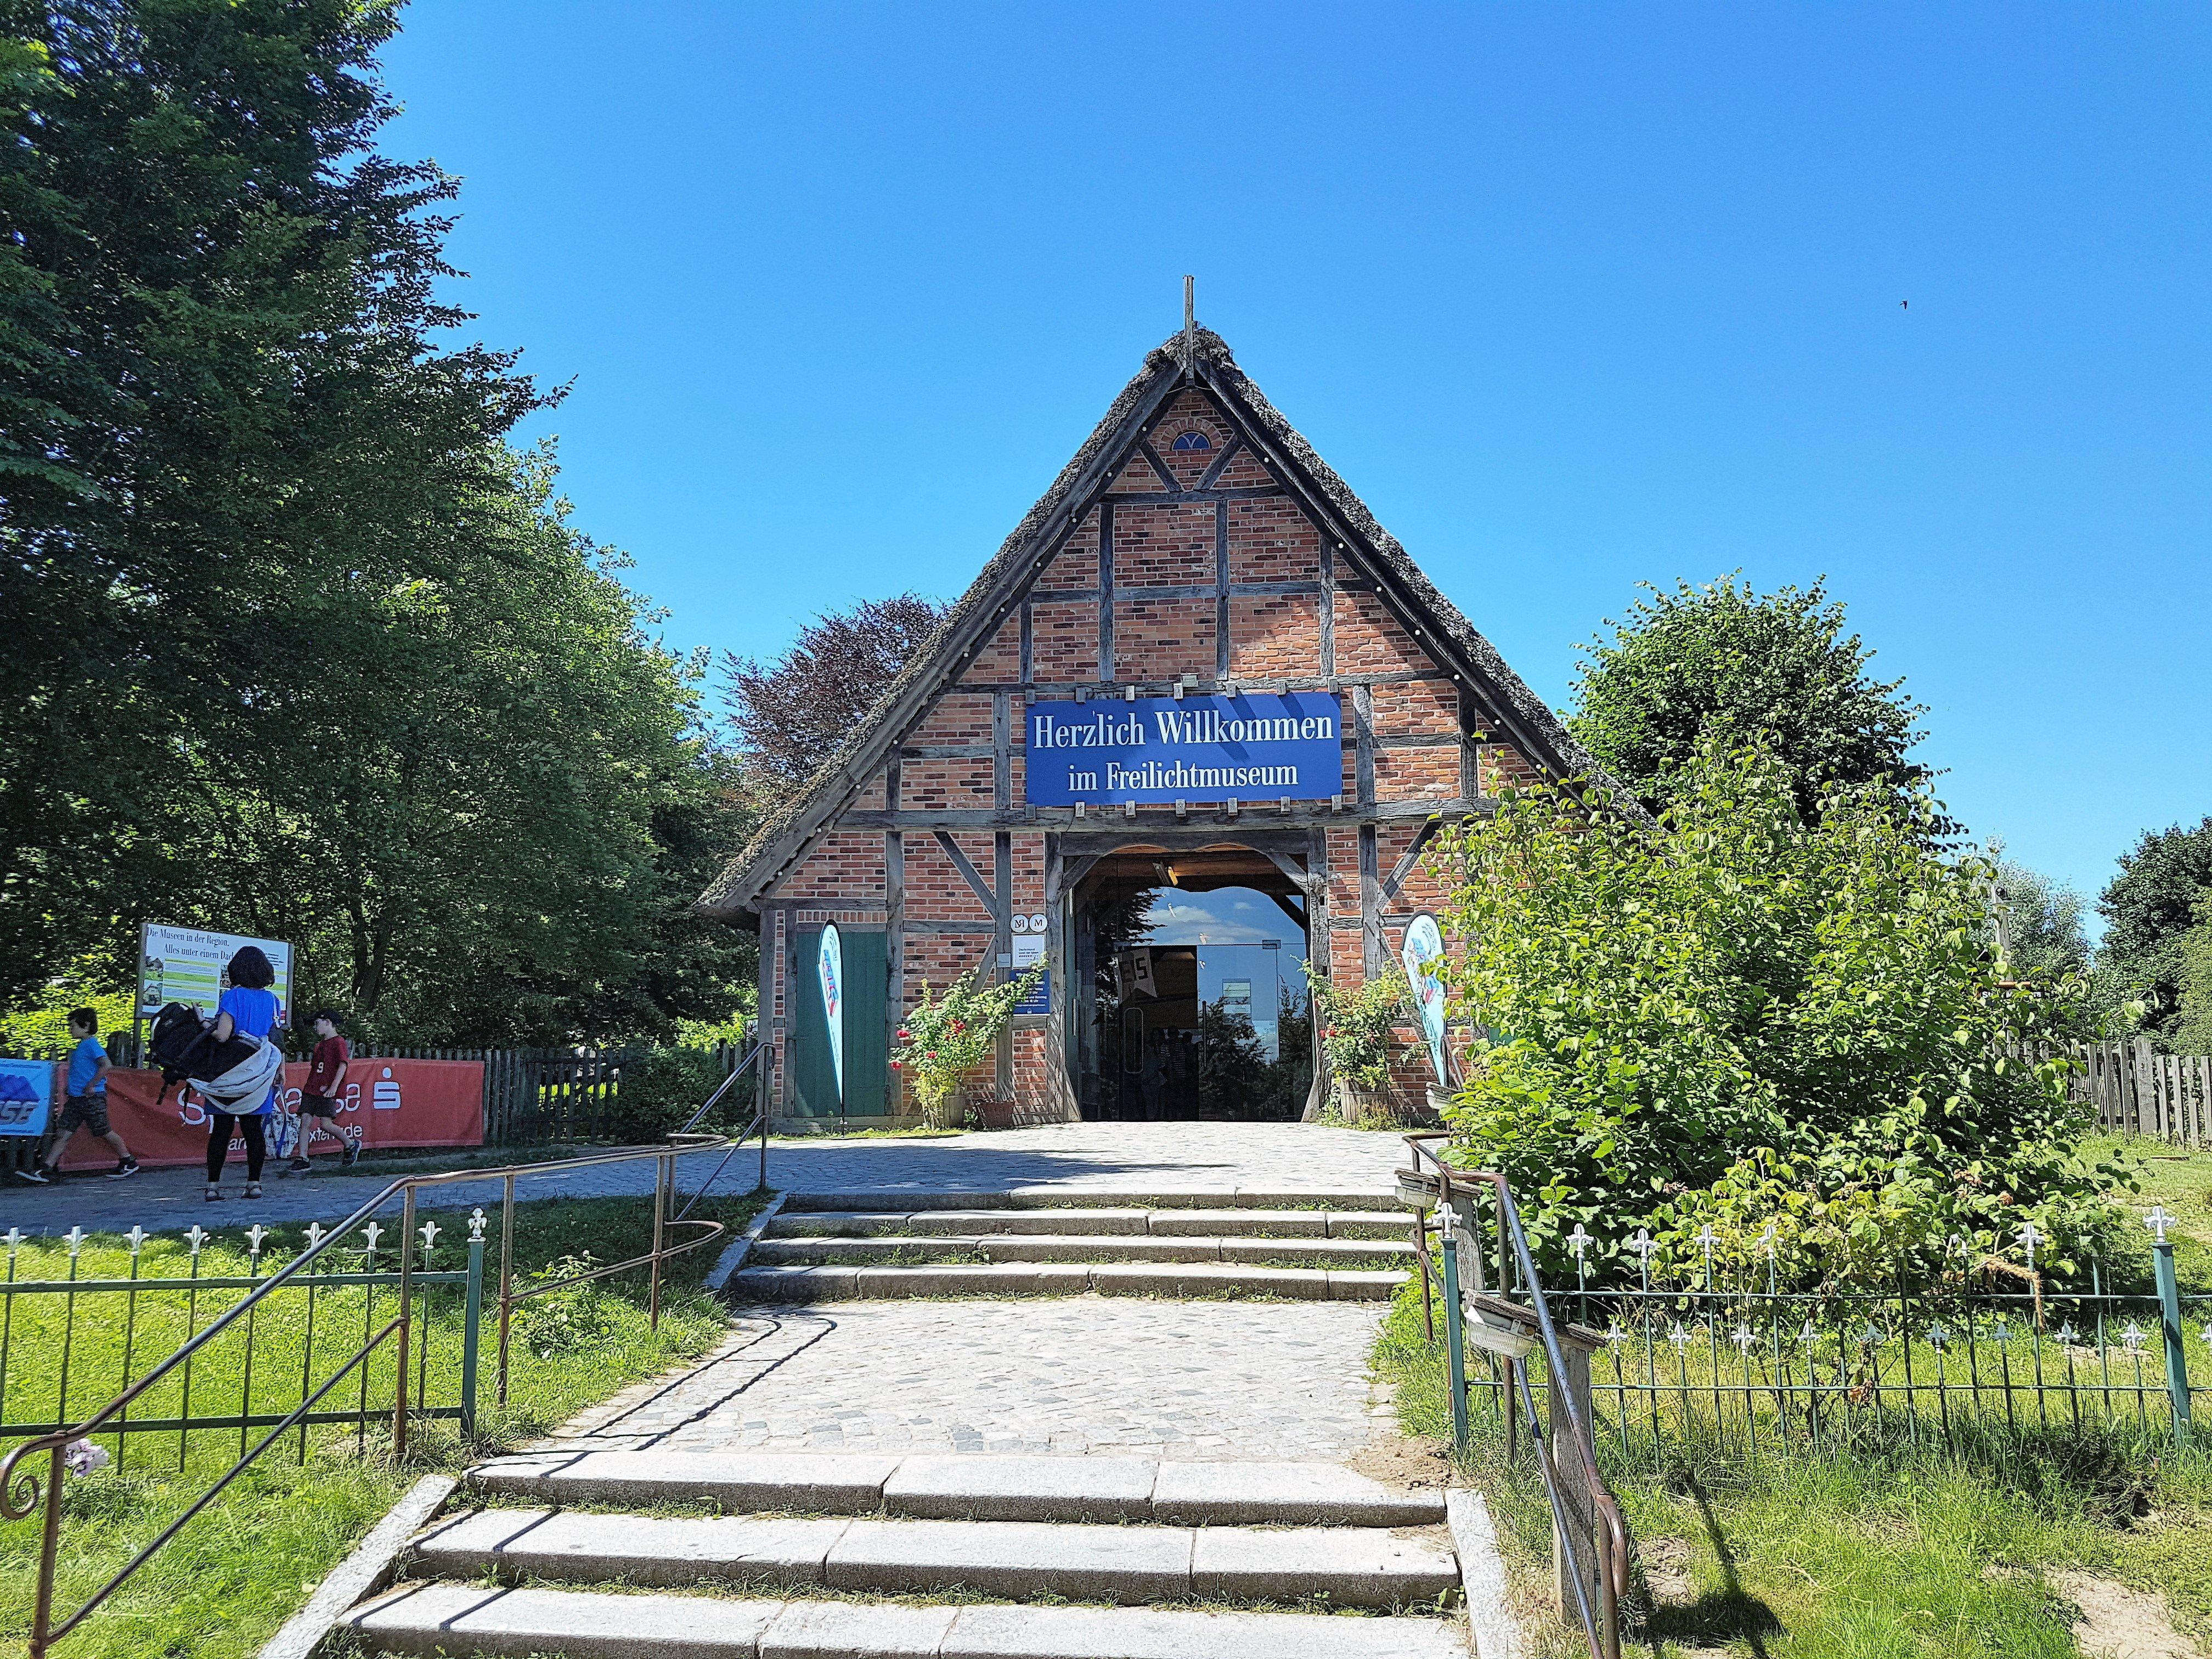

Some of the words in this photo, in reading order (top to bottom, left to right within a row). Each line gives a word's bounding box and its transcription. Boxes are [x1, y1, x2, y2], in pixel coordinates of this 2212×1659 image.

[1034, 713, 1146, 748] Herzlich
[1154, 710, 1334, 744] Willkommen
[1068, 765, 1098, 791] im
[1105, 760, 1299, 790] Freilichtmuseum
[146, 927, 158, 937] Die
[160, 928, 184, 941] Museen
[187, 932, 193, 942] in
[194, 933, 205, 944] der
[207, 935, 230, 948] Region.
[165, 943, 180, 955] Alles
[181, 947, 199, 957] unter
[200, 949, 219, 960] einem
[317, 1062, 324, 1073] 9
